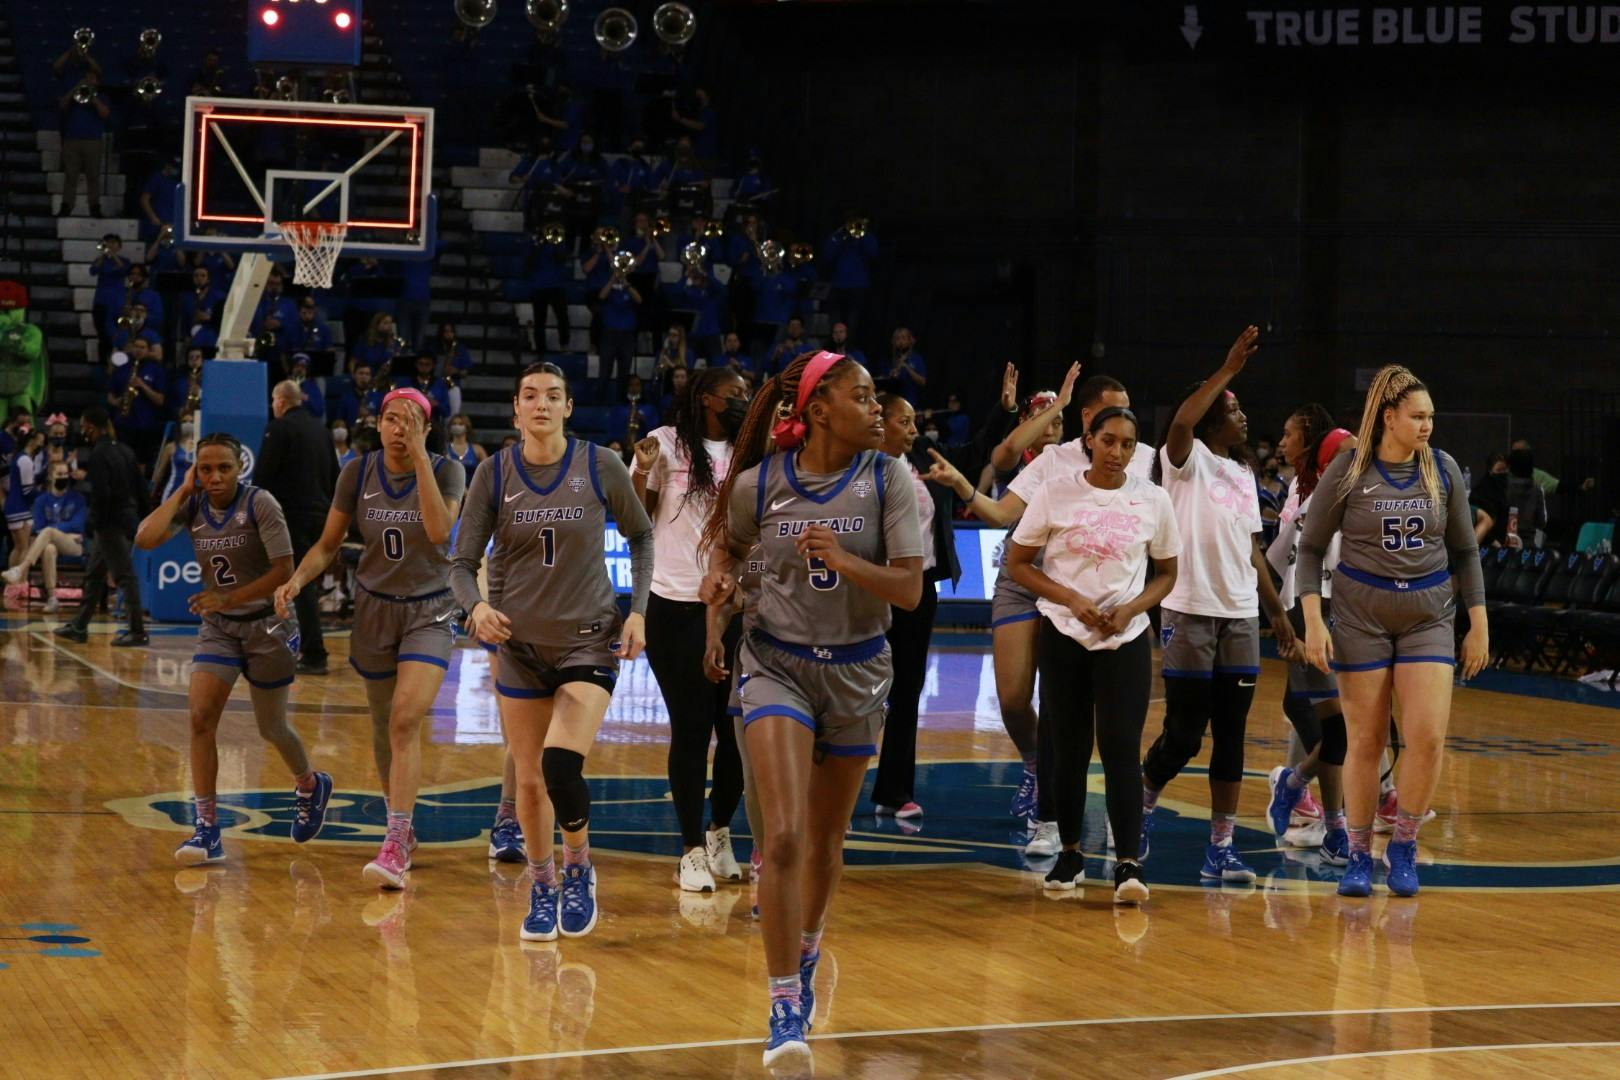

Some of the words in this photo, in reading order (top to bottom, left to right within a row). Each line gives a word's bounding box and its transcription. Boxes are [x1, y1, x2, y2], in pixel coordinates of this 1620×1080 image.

[1246, 8, 1360, 47] TRUE
[1372, 6, 1483, 45] BLUE
[1507, 5, 1620, 45] STUD
[513, 506, 585, 525] BUFFALO
[1381, 515, 1426, 552] 52
[382, 527, 405, 562] 0
[538, 527, 556, 568] 1
[210, 554, 238, 587] 2
